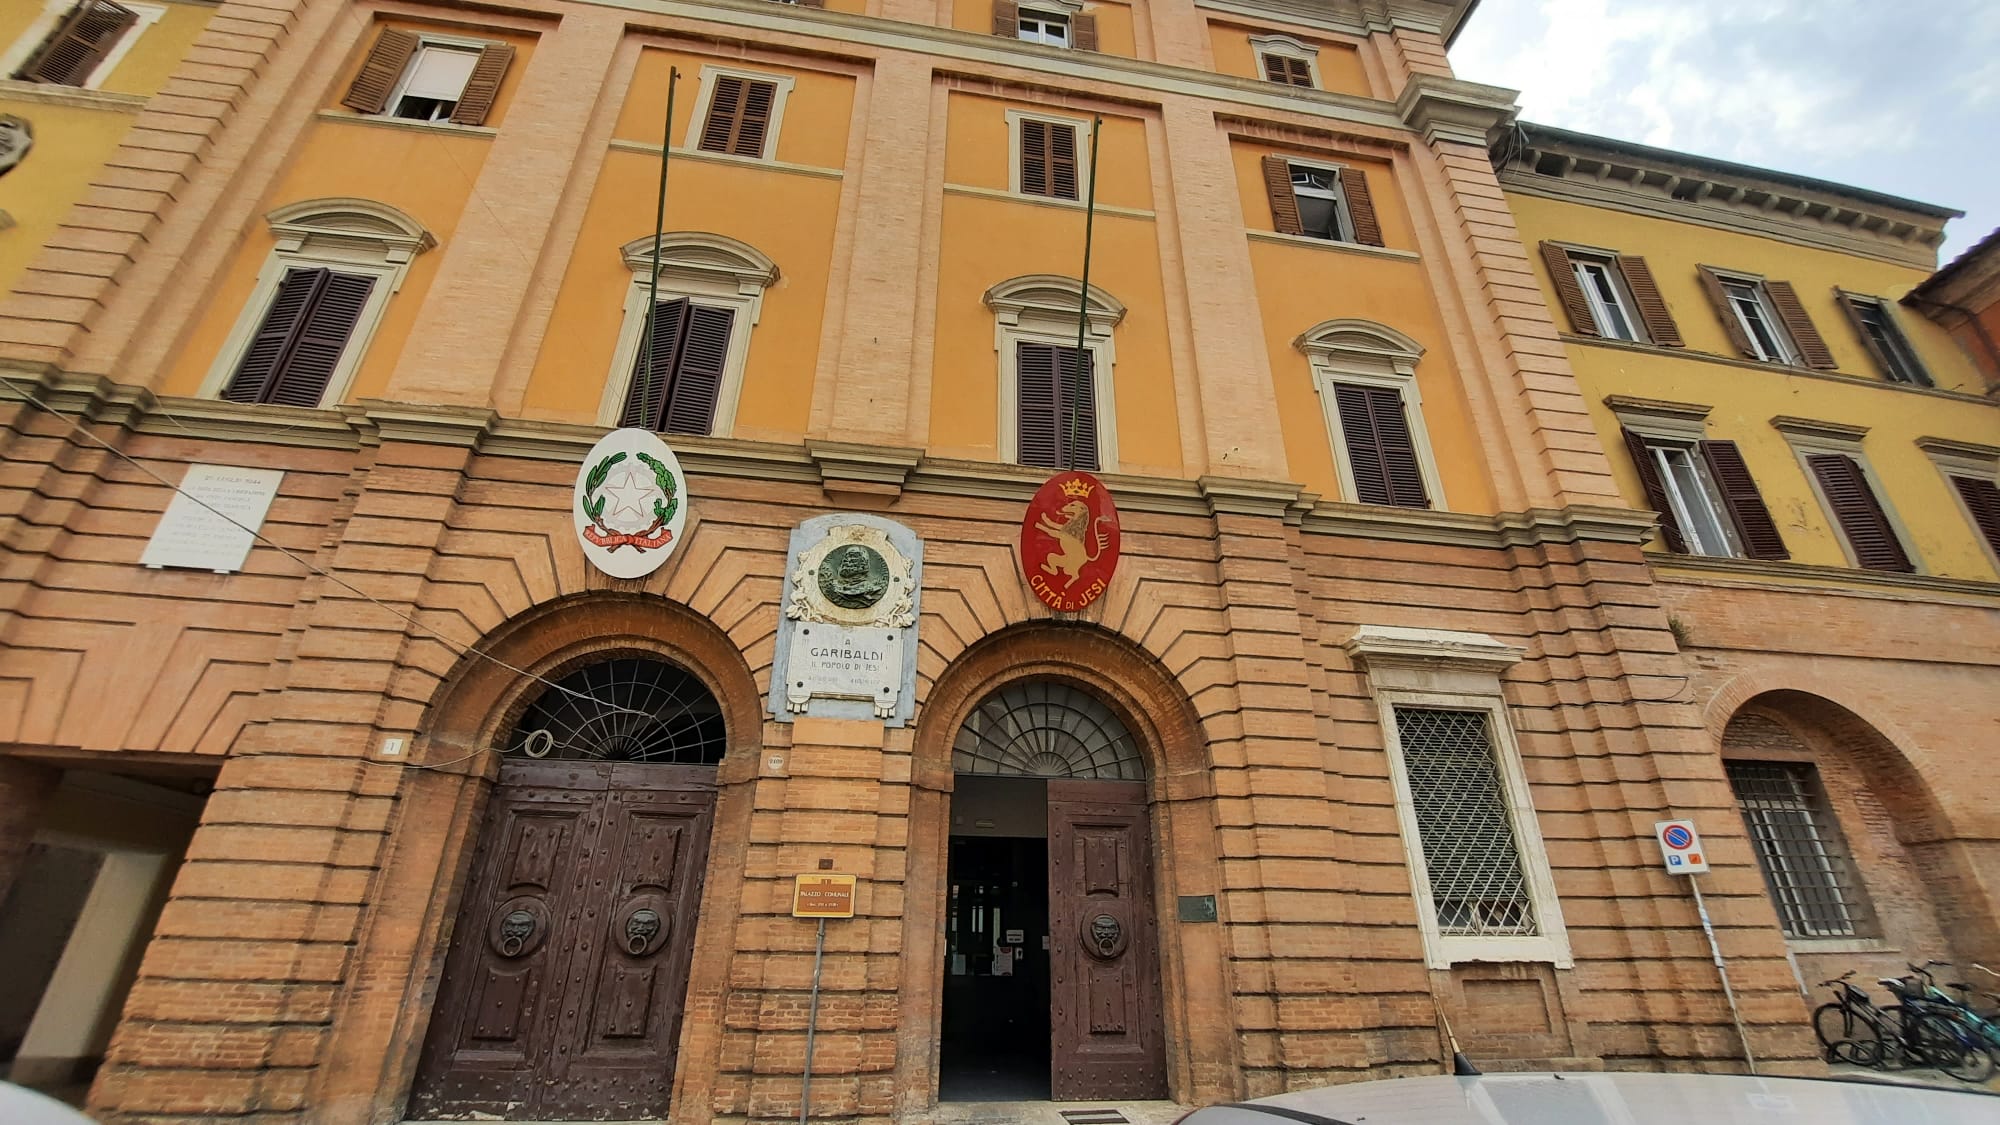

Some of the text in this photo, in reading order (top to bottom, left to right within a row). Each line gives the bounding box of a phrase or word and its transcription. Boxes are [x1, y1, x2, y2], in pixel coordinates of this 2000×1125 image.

[634, 532, 672, 548] ITALIANA
[1030, 574, 1106, 610] CITTÀ DI JESI
[810, 647, 883, 661] GARIBALDI
[821, 661, 851, 670] POPOLO
[854, 663, 861, 671] DI
[1670, 856, 1680, 865] P
